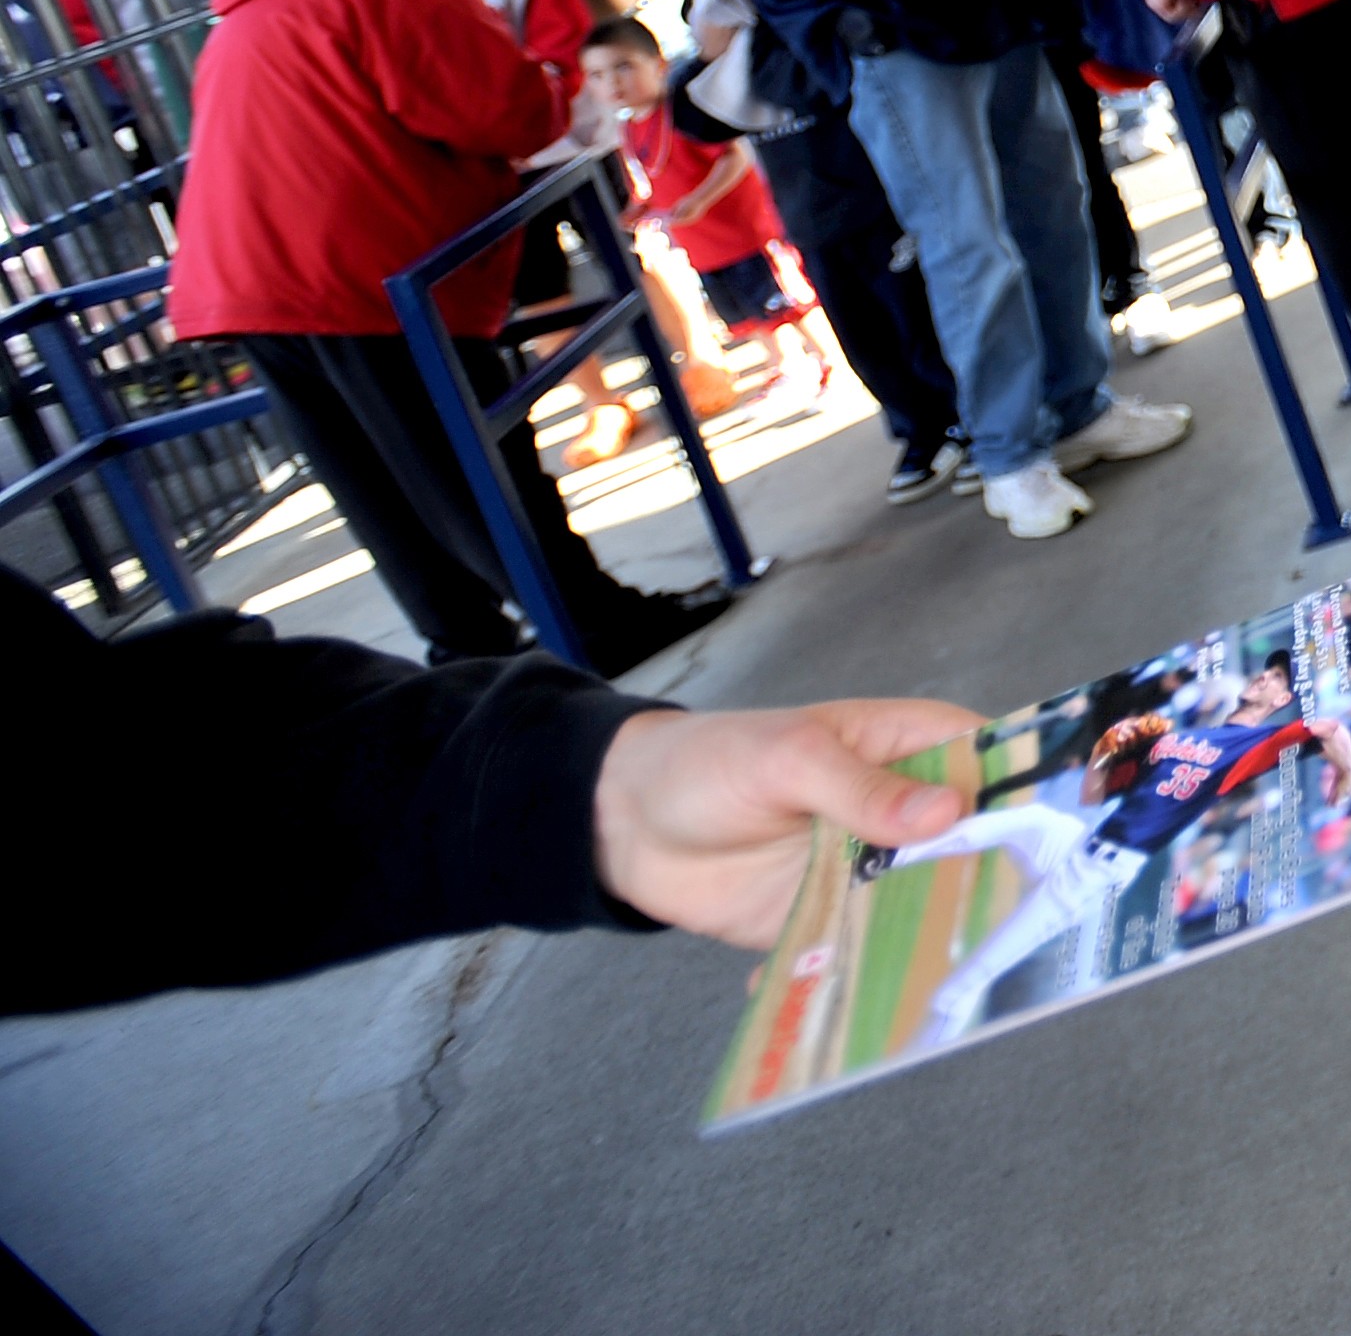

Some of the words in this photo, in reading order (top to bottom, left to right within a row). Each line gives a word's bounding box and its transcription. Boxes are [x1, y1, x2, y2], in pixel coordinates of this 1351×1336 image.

[1329, 585, 1344, 627] Tacoma
[1333, 627, 1348, 675] Rainiers
[1300, 695, 1316, 728] 2010
[1156, 764, 1211, 801] 35
